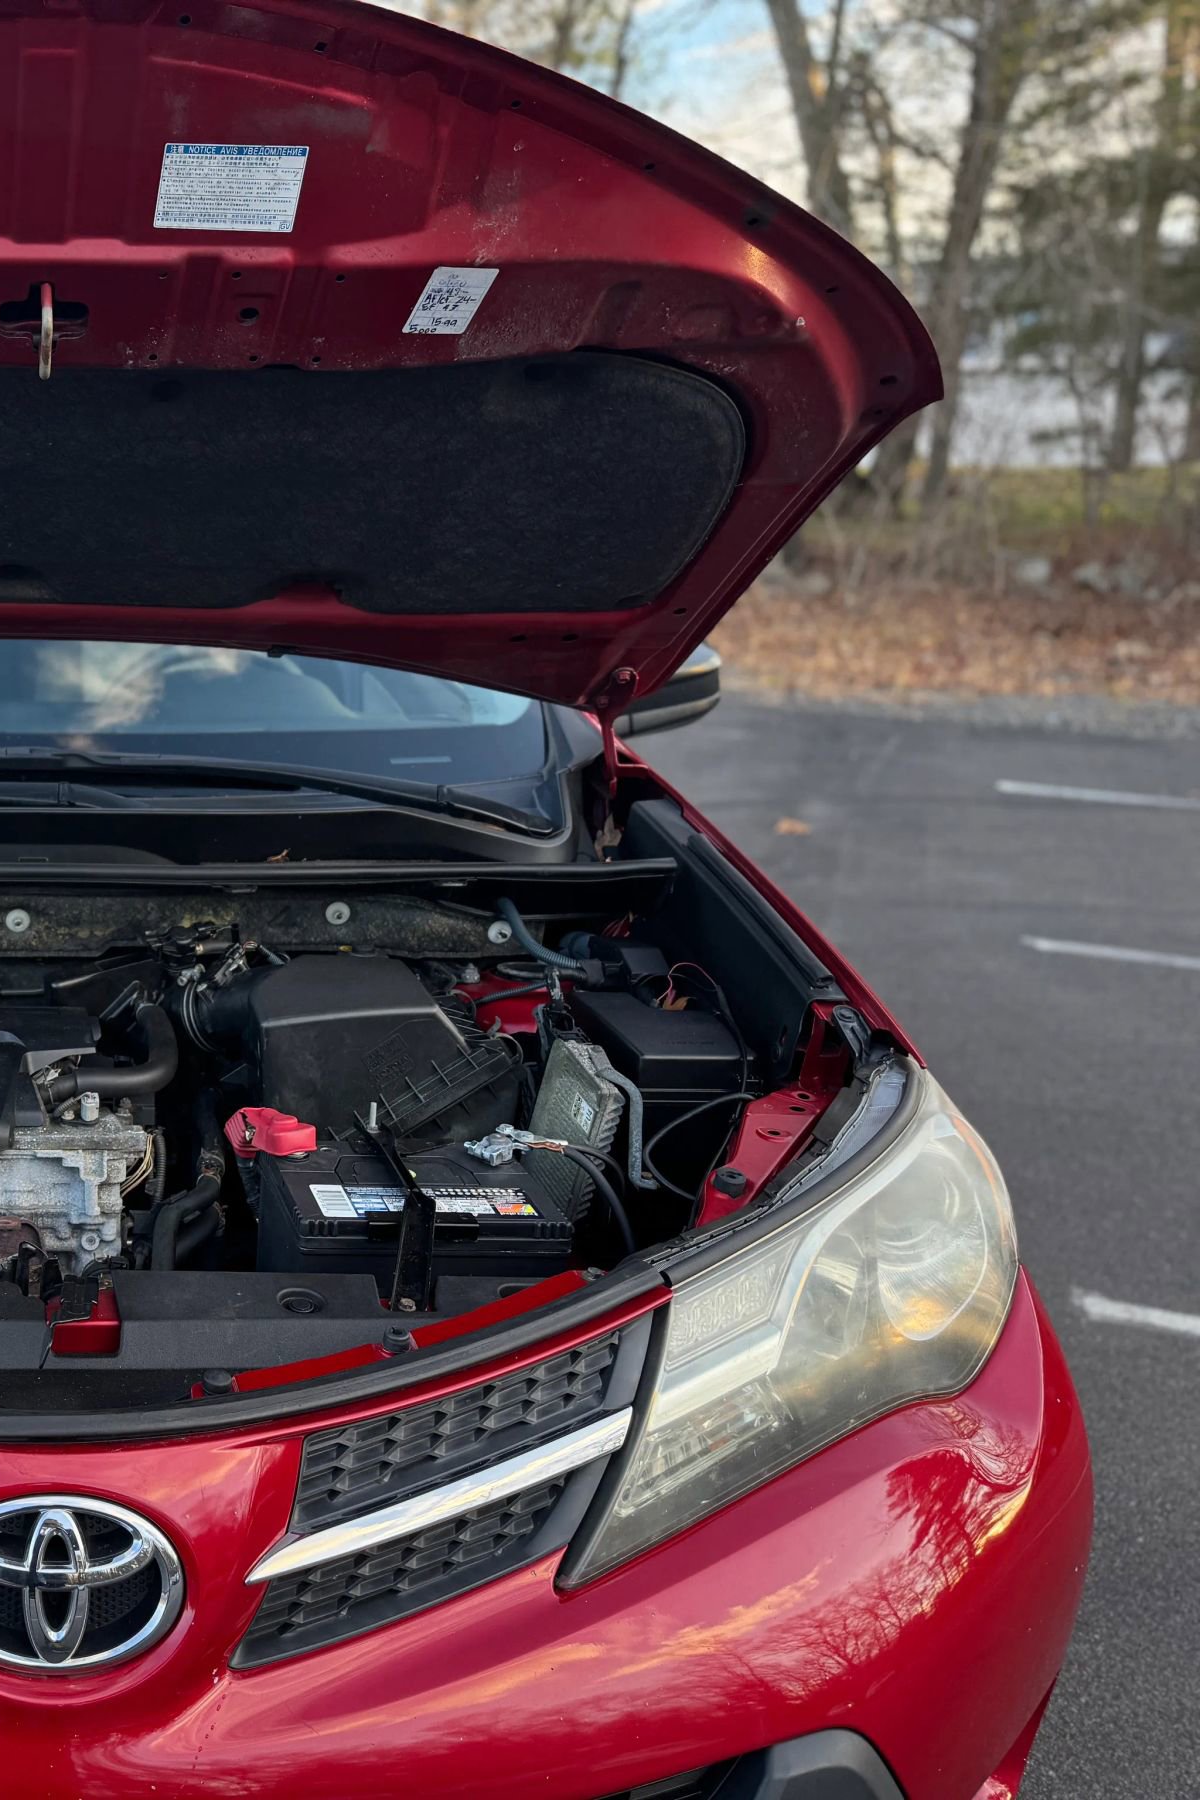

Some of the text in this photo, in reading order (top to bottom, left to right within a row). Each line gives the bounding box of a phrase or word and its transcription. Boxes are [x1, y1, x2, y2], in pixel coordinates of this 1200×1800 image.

[188, 146, 238, 154] NOTICE AVIS
[242, 147, 303, 157] УВЕДОМЛЕНИЕ
